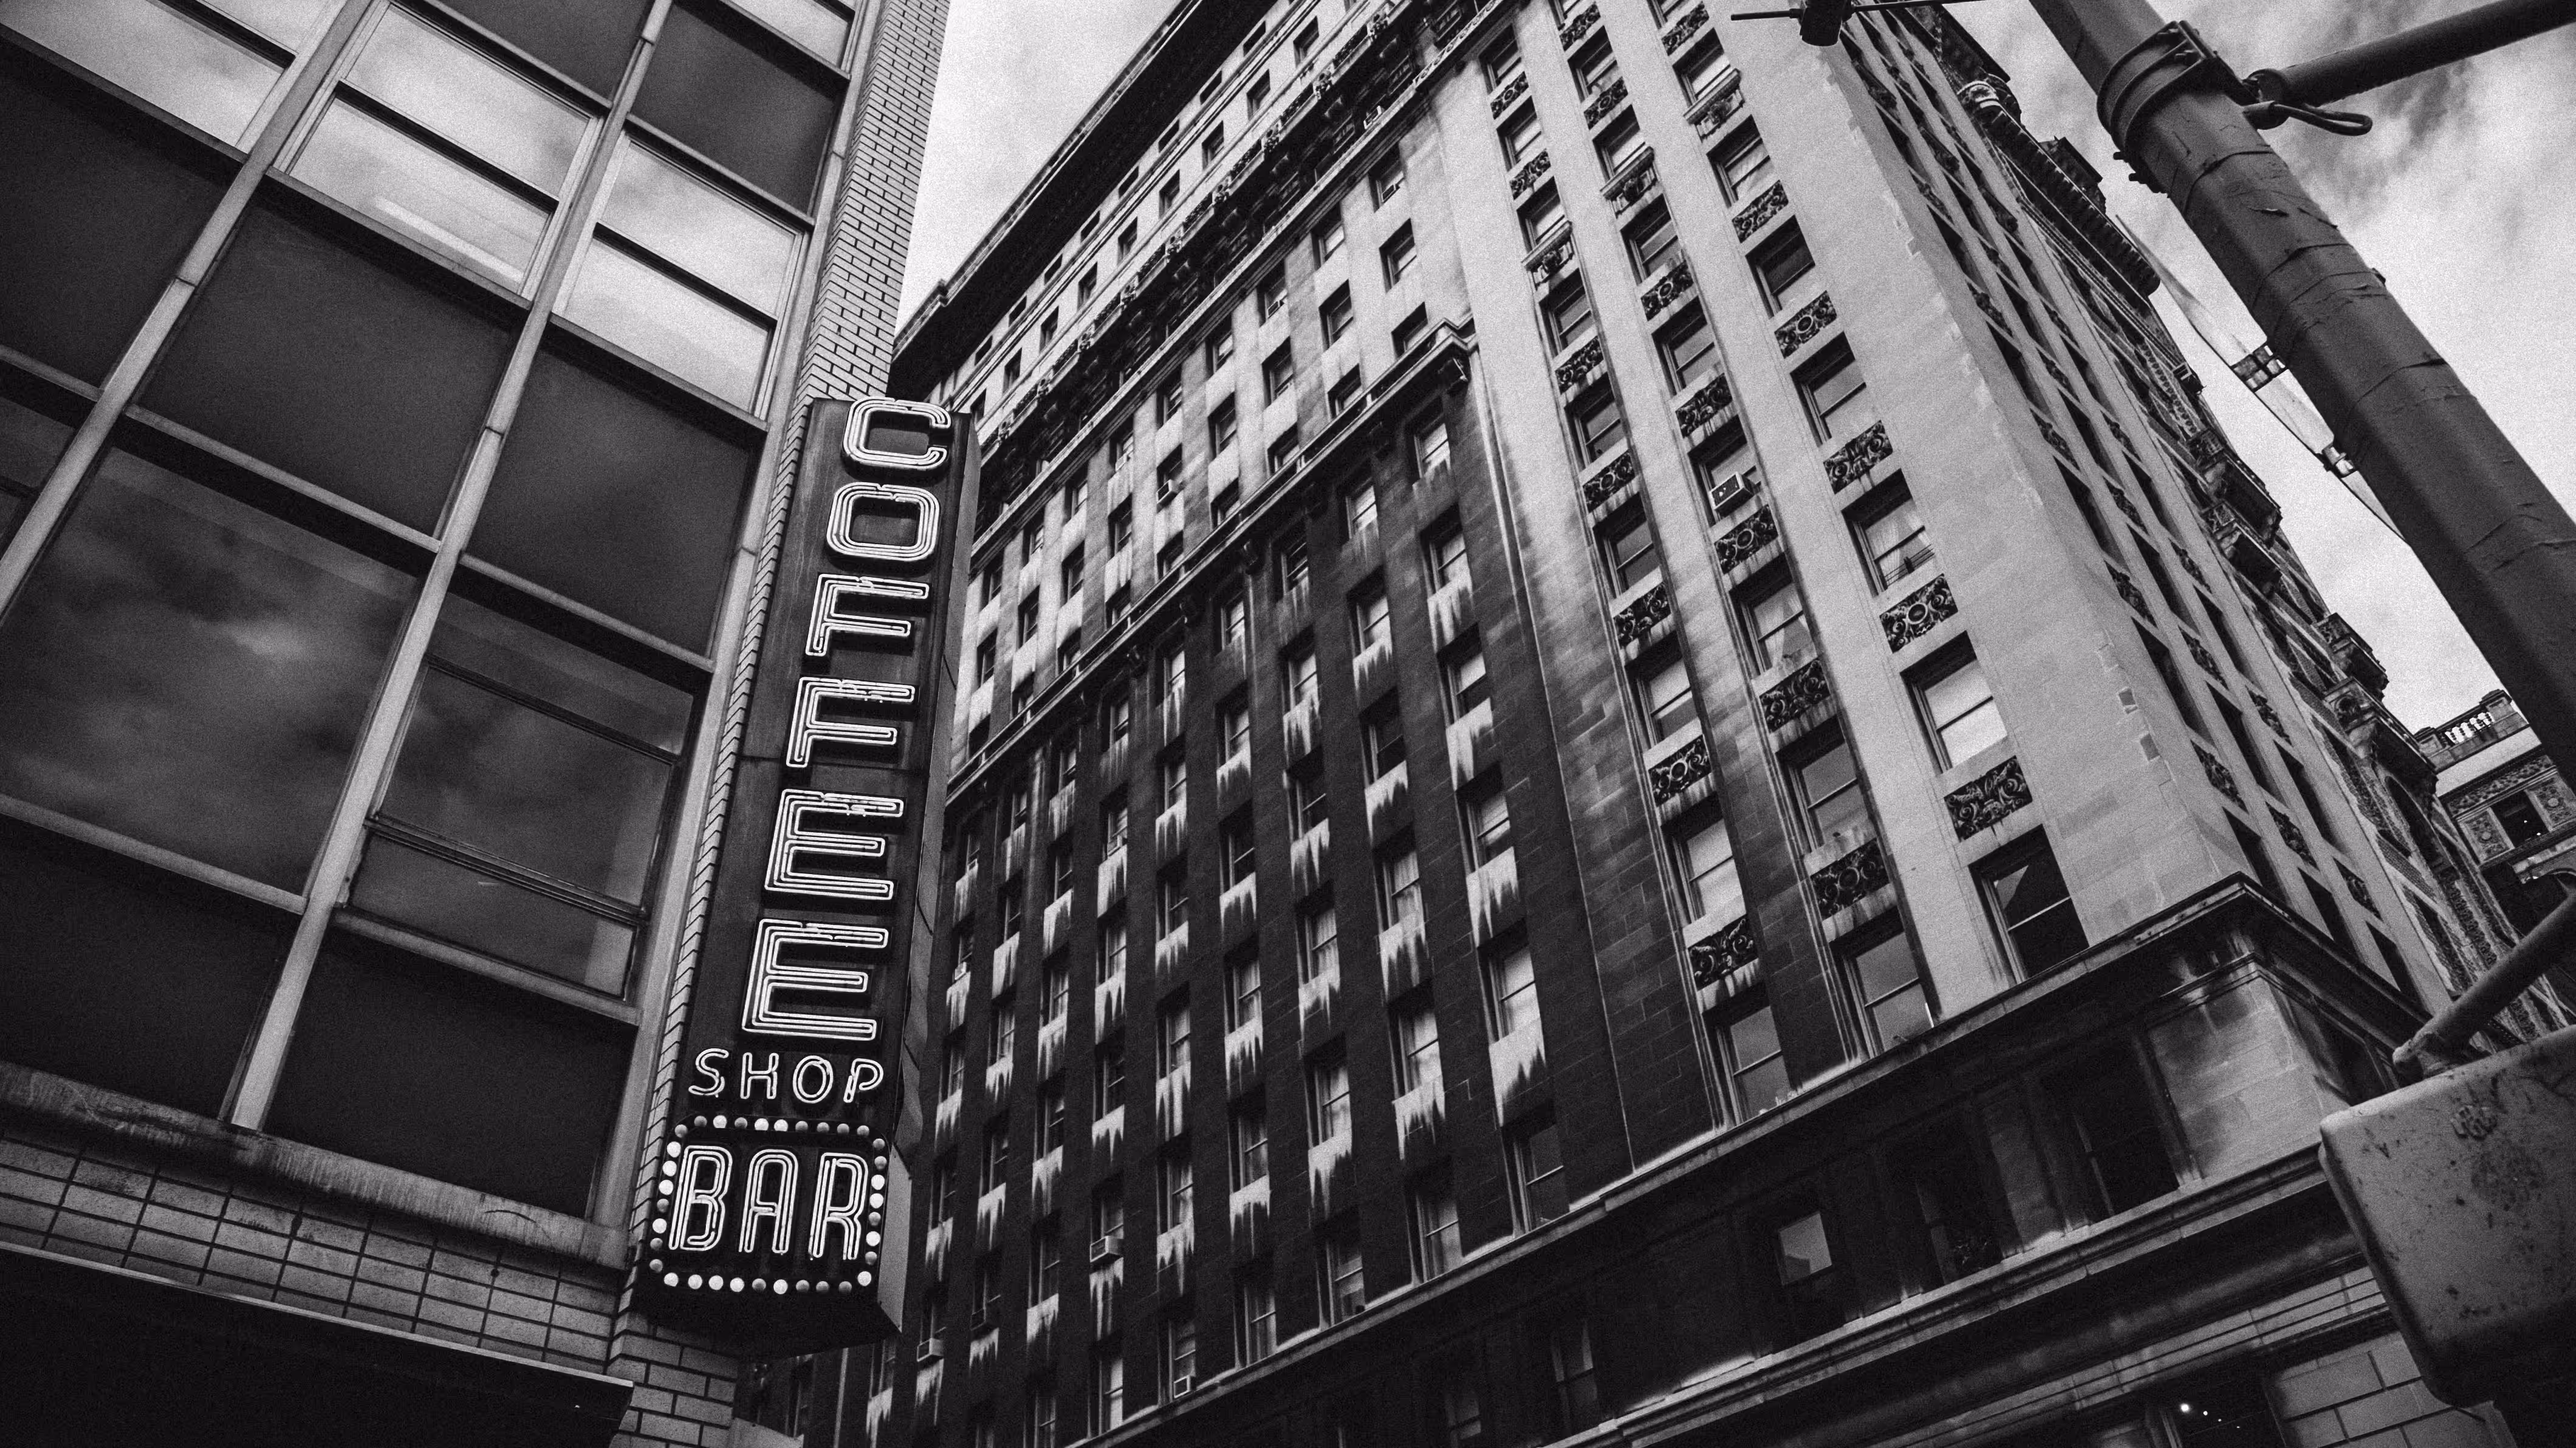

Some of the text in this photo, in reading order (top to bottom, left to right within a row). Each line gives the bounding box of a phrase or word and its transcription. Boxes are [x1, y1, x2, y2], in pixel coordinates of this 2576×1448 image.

[742, 396, 951, 1040] COFFEE
[688, 1048, 884, 1104] SHOP
[668, 1145, 869, 1260] BAR
